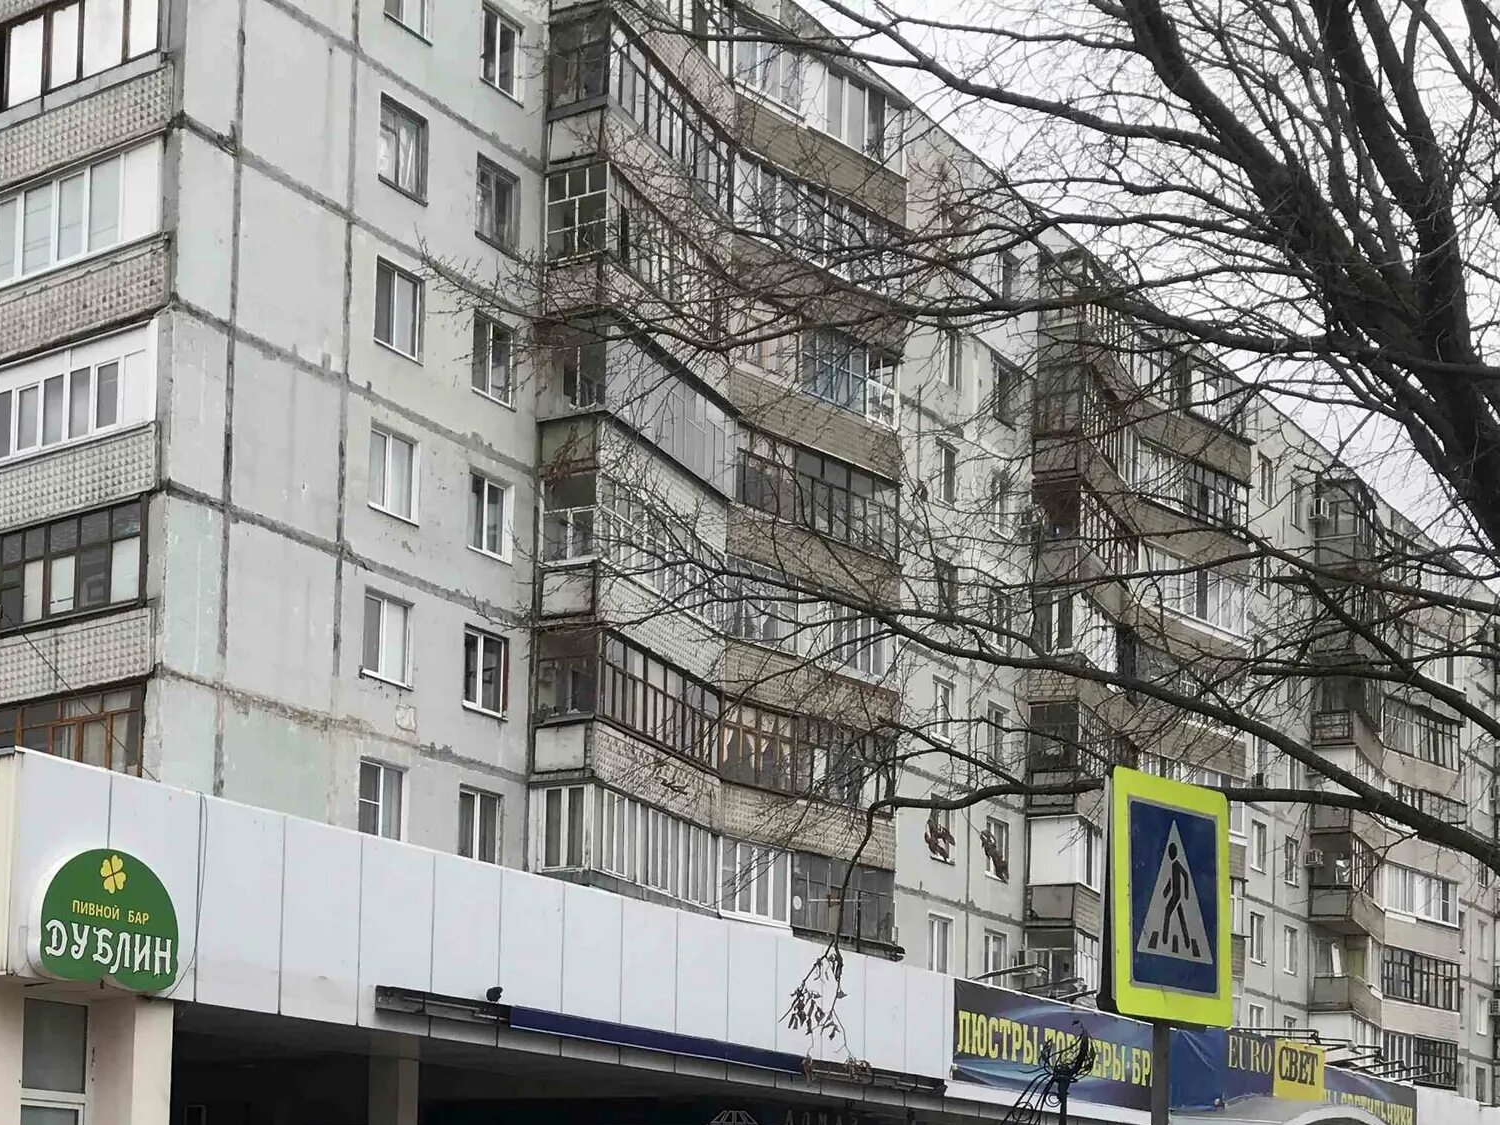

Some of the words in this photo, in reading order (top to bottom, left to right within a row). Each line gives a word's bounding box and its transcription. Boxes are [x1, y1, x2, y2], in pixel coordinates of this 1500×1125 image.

[72, 899, 120, 921] ПИВНОЙ
[127, 910, 150, 925] БАР
[45, 919, 172, 976] ДУБЛИН
[957, 1010, 1039, 1067] ЛЮСТРЫ
[1228, 1034, 1273, 1076] EURO
[1278, 1045, 1319, 1087] СВЕТ
